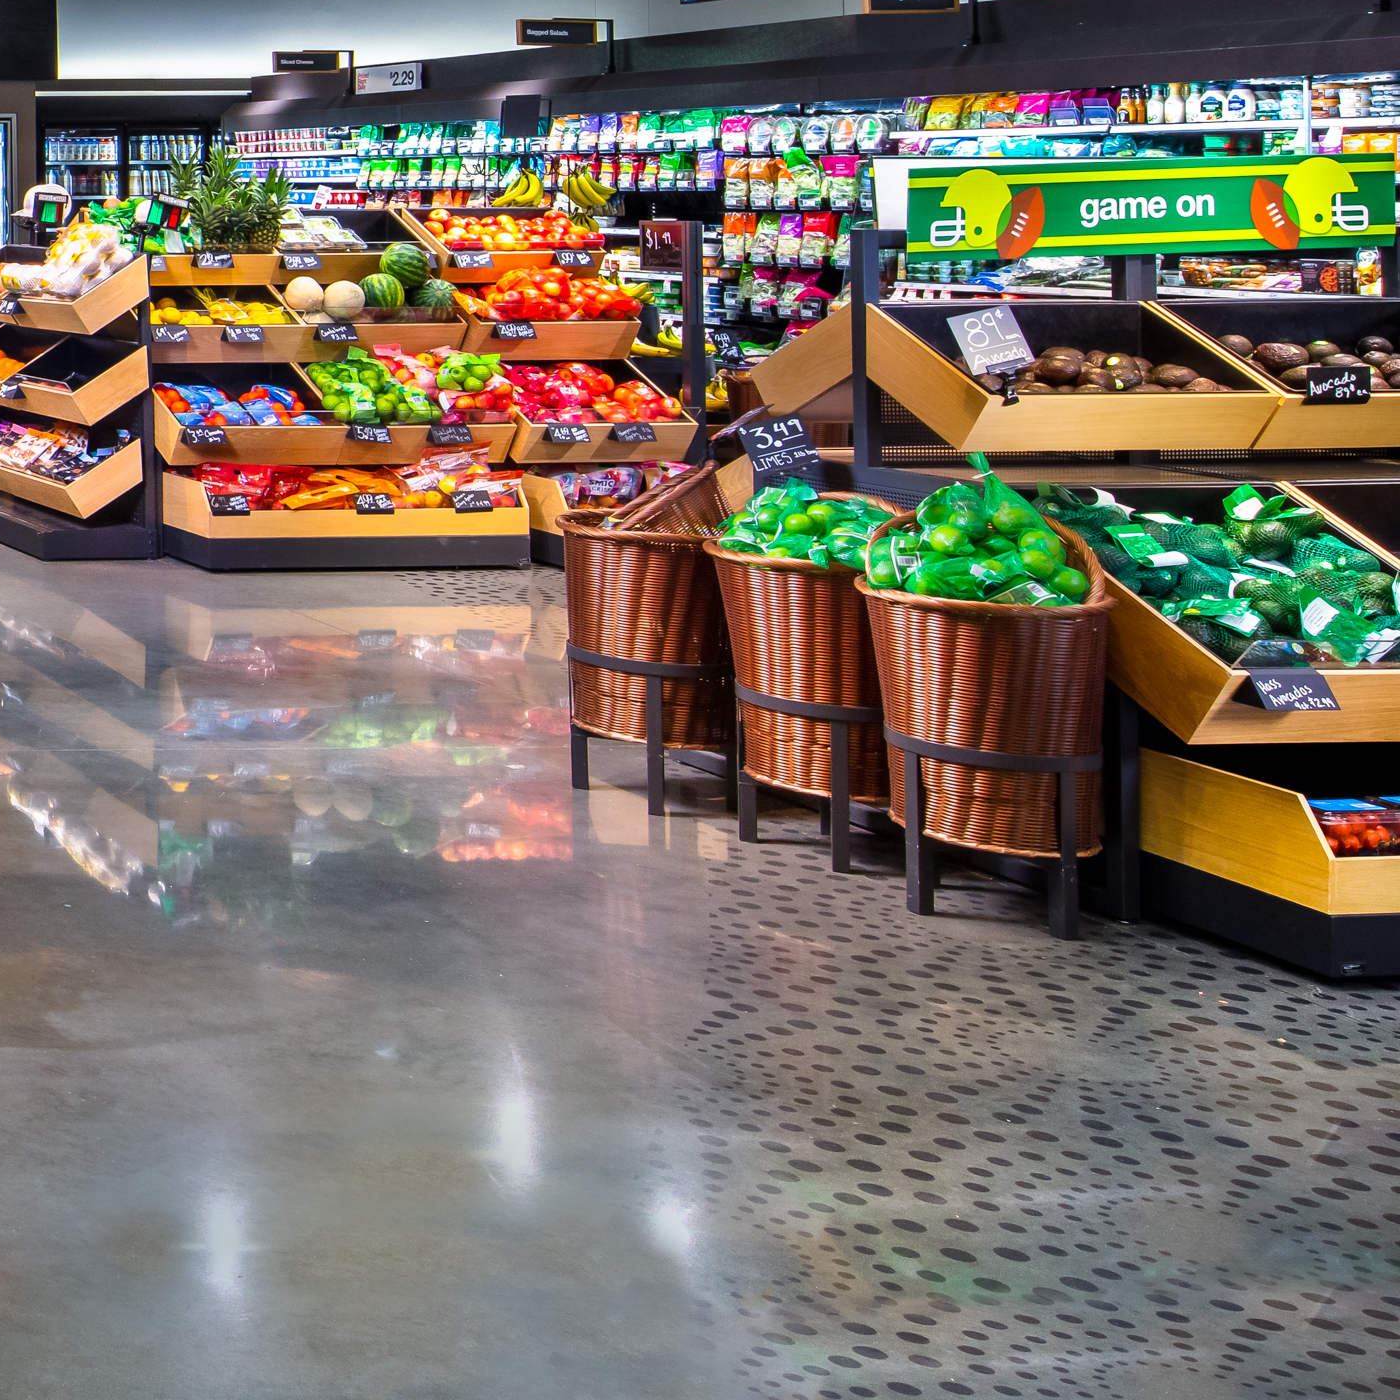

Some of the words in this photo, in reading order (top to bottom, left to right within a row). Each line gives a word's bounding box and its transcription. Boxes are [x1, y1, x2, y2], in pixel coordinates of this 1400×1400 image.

[526, 28, 548, 37] Bagged
[389, 70, 415, 86] $2.29
[1080, 196, 1167, 228] game
[1176, 194, 1215, 217] on
[972, 347, 1028, 372] Avocado
[1309, 371, 1357, 397] Avocado
[739, 418, 804, 450] $3.49
[752, 452, 793, 473] LIMES
[1255, 678, 1282, 695] Hass
[1268, 684, 1314, 708] Avocados
